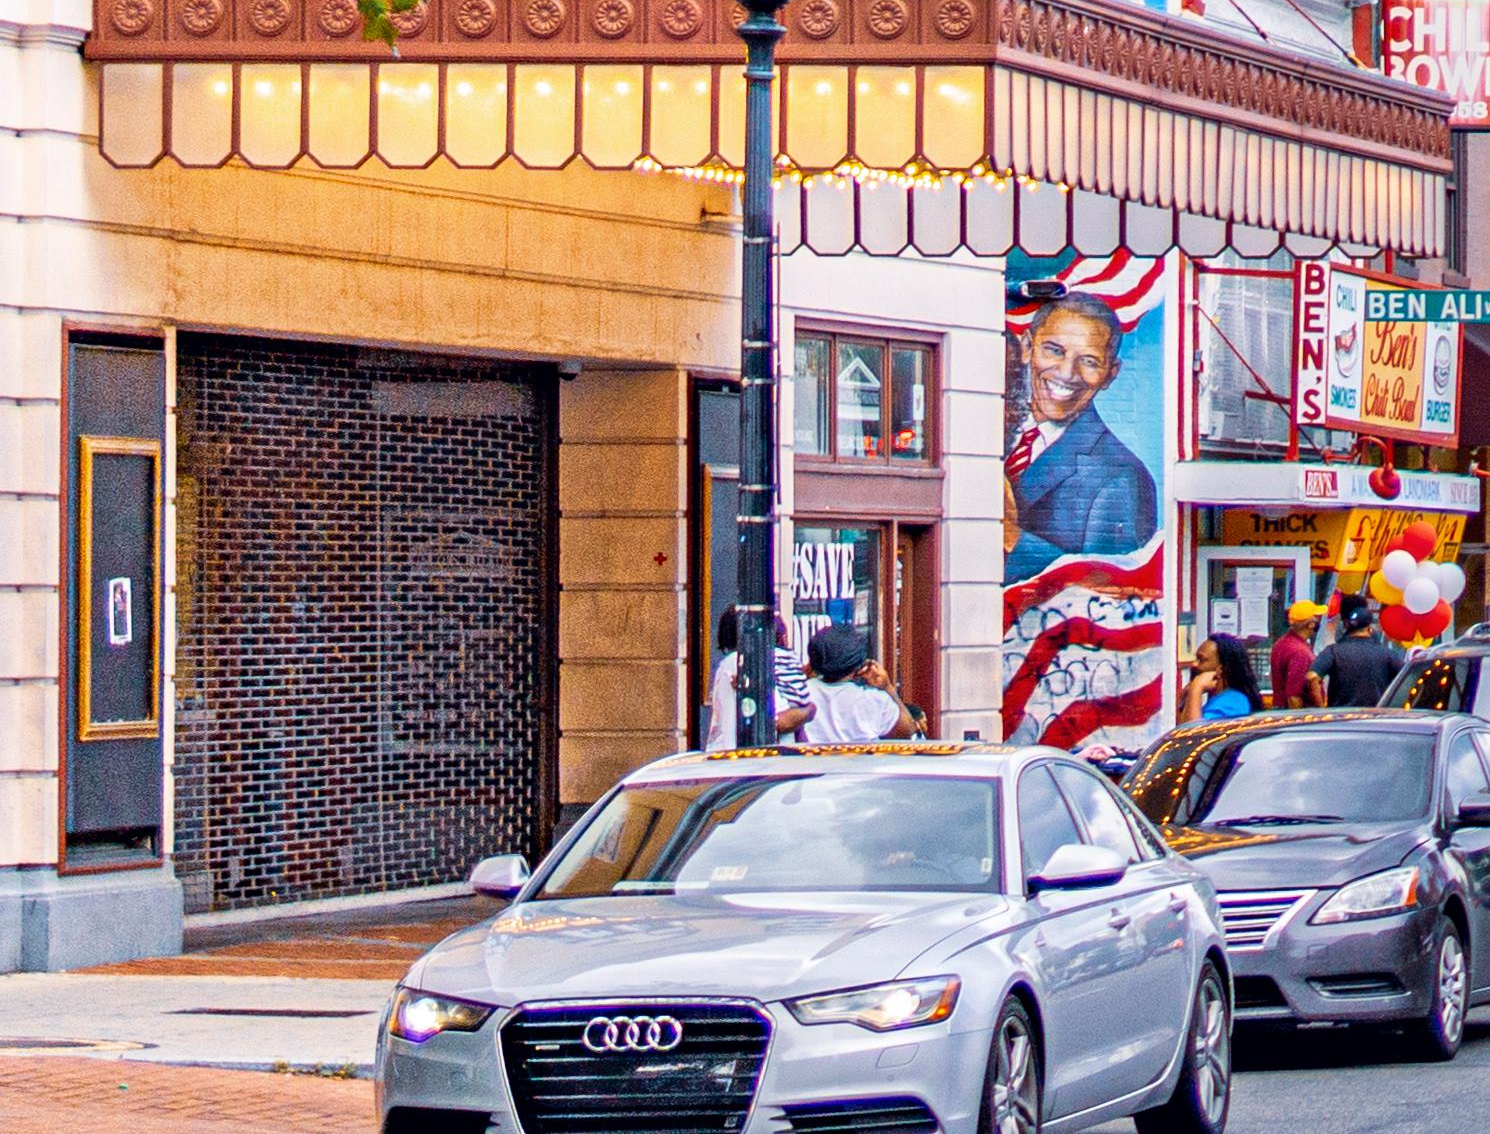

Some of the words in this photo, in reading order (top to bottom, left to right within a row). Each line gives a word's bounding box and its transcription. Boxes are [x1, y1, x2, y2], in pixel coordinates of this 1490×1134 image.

[1368, 292, 1426, 319] BEN
[1440, 294, 1482, 320] ALI
[1301, 263, 1326, 420] BEN'S
[1250, 513, 1318, 533] THICK
